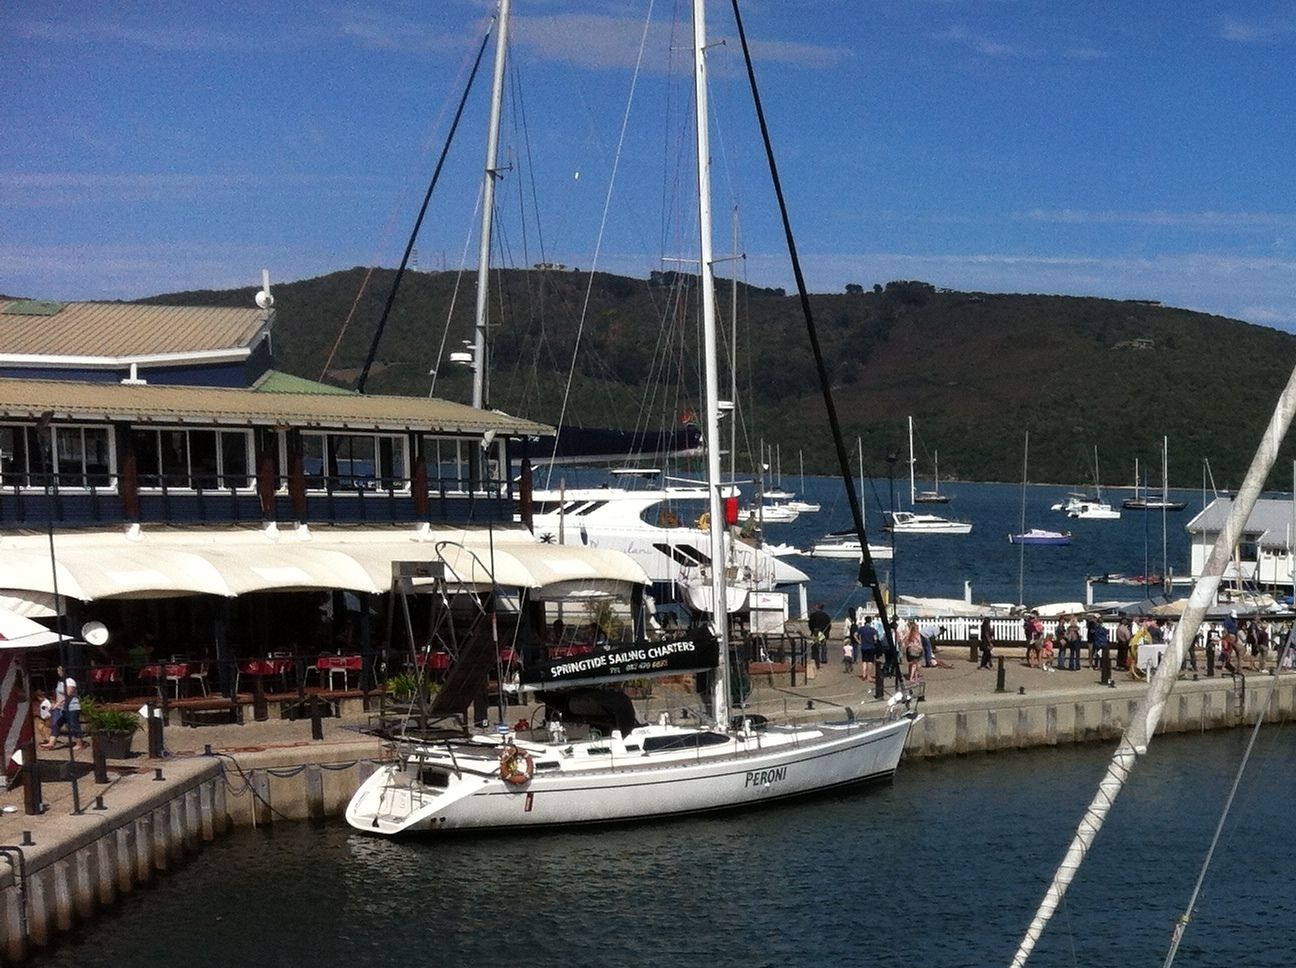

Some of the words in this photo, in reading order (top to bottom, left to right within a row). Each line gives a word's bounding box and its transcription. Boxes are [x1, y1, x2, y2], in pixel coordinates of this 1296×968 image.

[550, 655, 607, 678] SPRINGTIDE
[608, 649, 647, 665] SAILING
[647, 641, 696, 659] CHARTERS
[744, 766, 787, 788] PERONI
